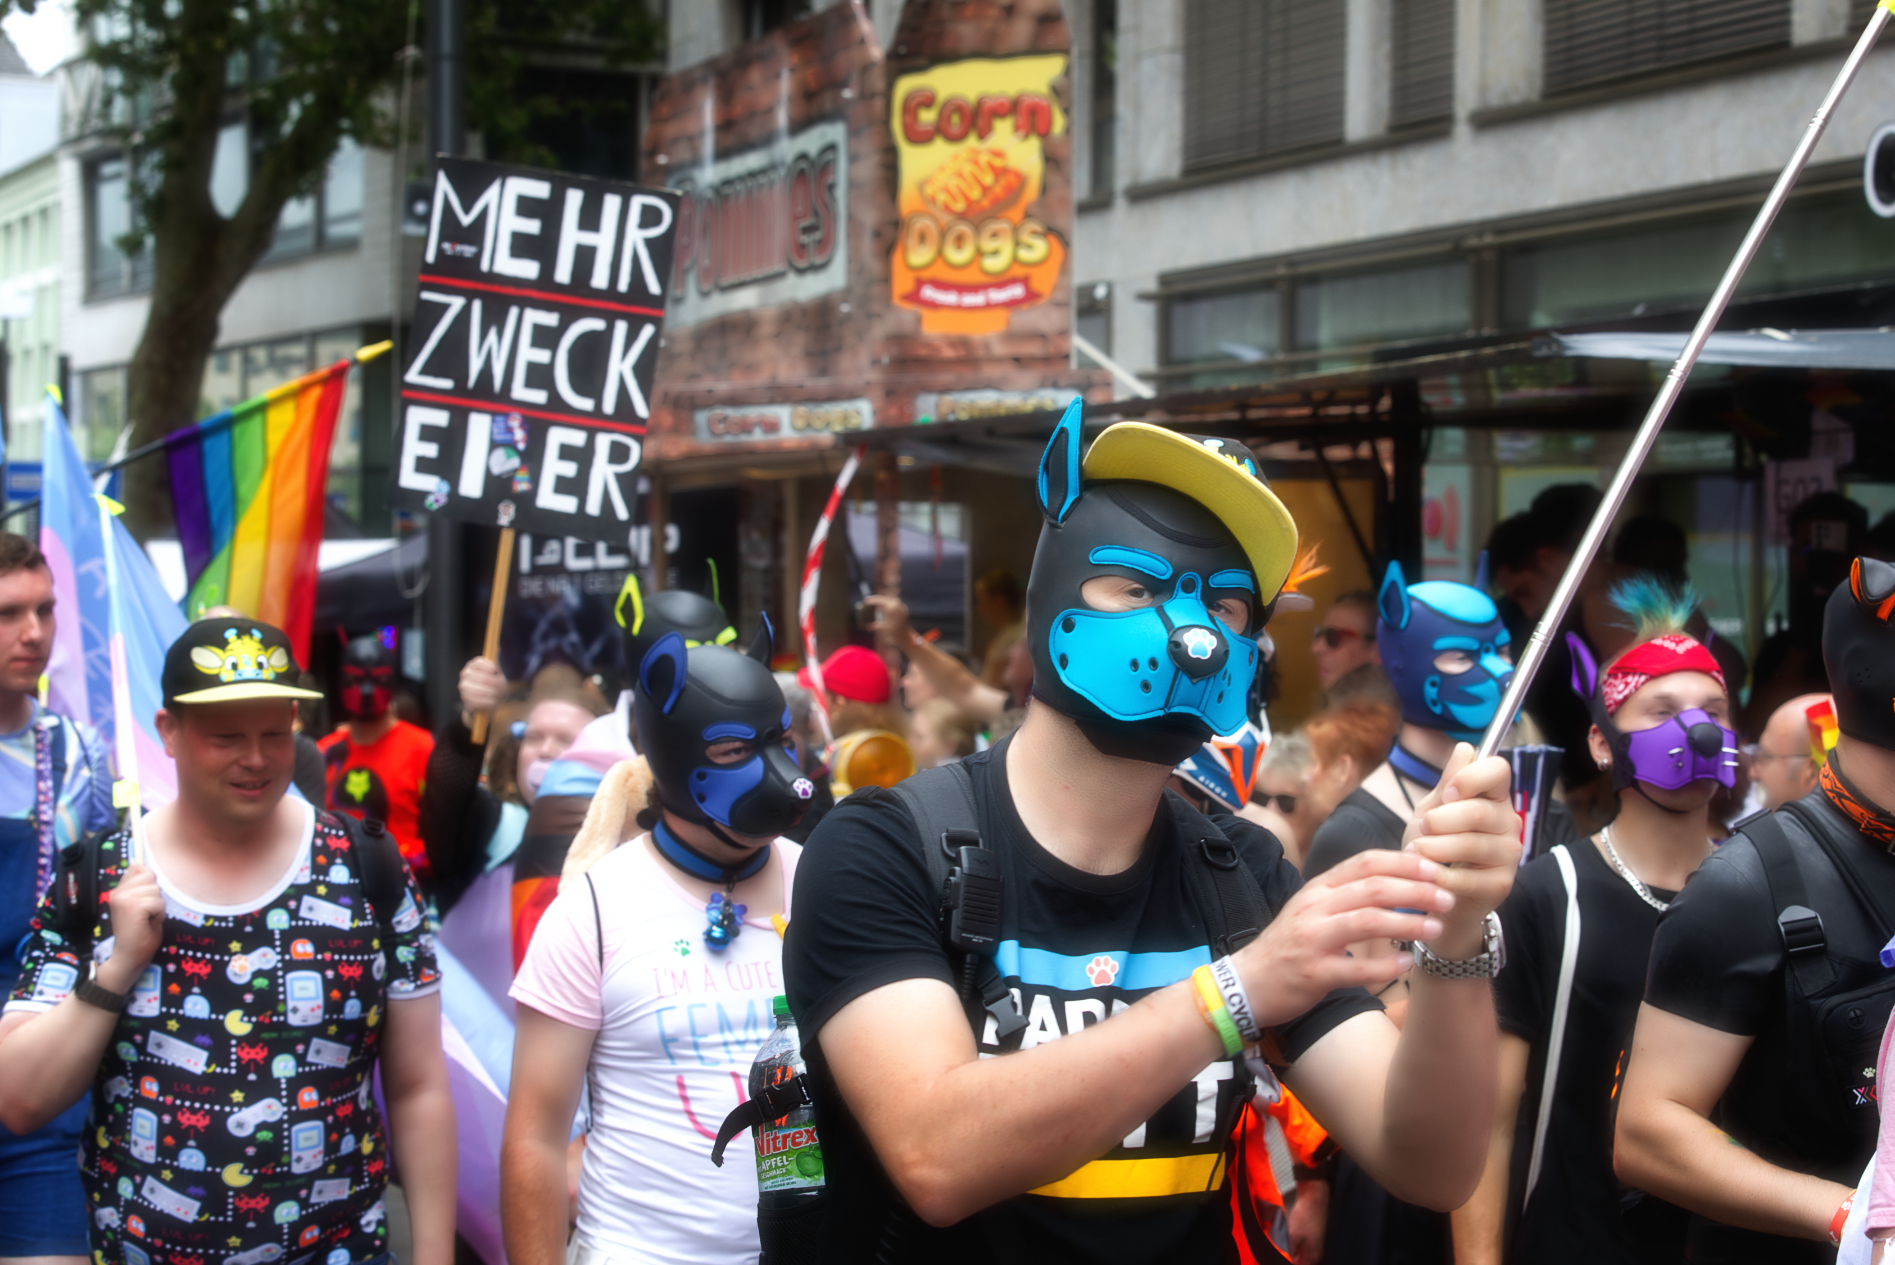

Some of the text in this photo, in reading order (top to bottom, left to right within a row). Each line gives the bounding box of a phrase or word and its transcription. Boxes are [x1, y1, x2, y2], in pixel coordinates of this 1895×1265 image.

[902, 86, 1052, 144] Corn
[425, 169, 673, 296] MEHR
[904, 212, 1049, 274] Dogs
[403, 290, 656, 419] ZWECK
[398, 405, 641, 521] EIER
[652, 961, 777, 998] I'M A CUTE
[755, 1123, 818, 1157] Vitrex
